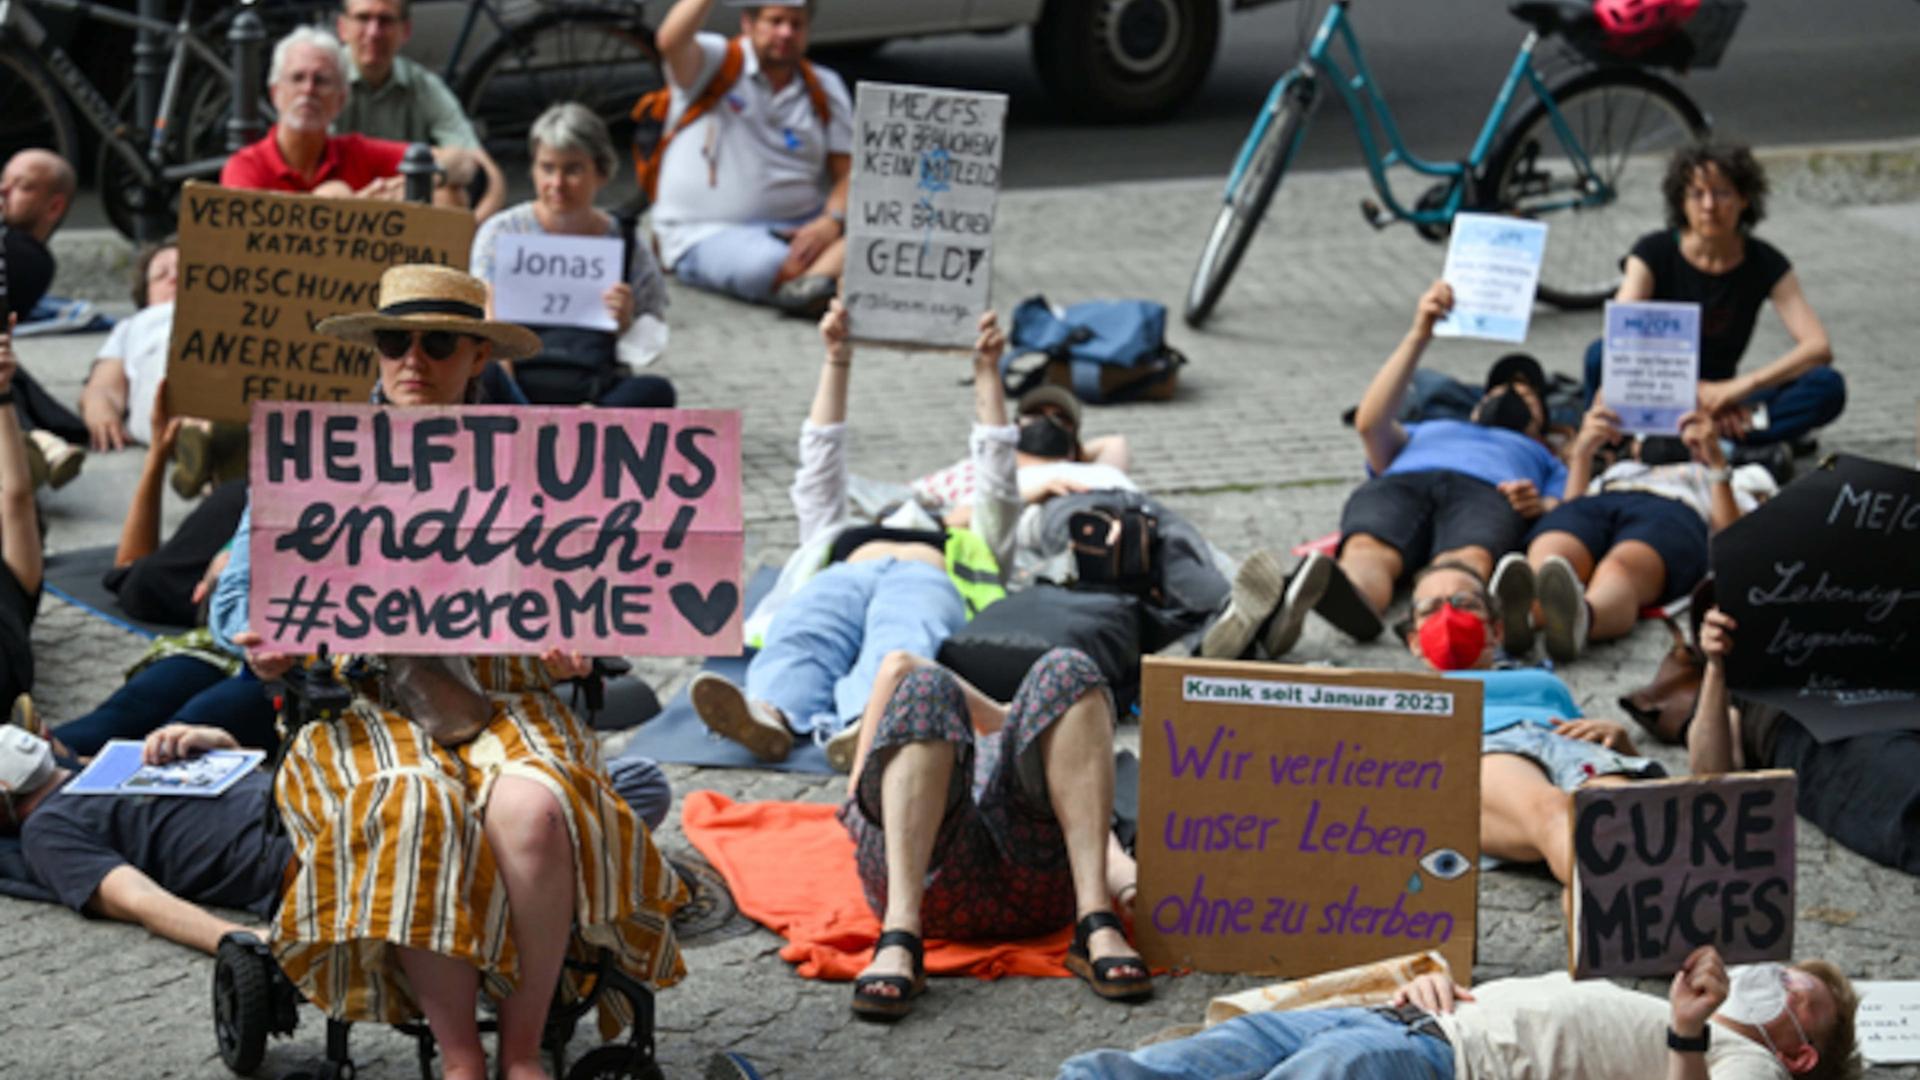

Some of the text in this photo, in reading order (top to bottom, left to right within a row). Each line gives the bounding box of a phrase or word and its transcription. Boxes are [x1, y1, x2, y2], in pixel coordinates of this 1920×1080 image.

[864, 121, 905, 149] WIR
[863, 152, 916, 177] KEIN
[190, 197, 406, 237] VERSORGUNG
[864, 201, 901, 226] WIR
[511, 246, 605, 279] Jonas
[866, 238, 985, 287] GELD!
[240, 302, 280, 329] ZU
[542, 293, 571, 315] 27
[266, 410, 716, 500] HELFT UNS
[275, 485, 697, 577] endlich!
[266, 575, 653, 643] #severeME
[1186, 680, 1450, 713] Krank seit Januar 2023
[1162, 718, 1444, 791] Wir verlieren
[1163, 799, 1427, 856] unser Leben
[1576, 789, 1776, 877] CURE
[1151, 873, 1455, 944] ohne zu sterben
[1581, 872, 1789, 969] ME/CFS
